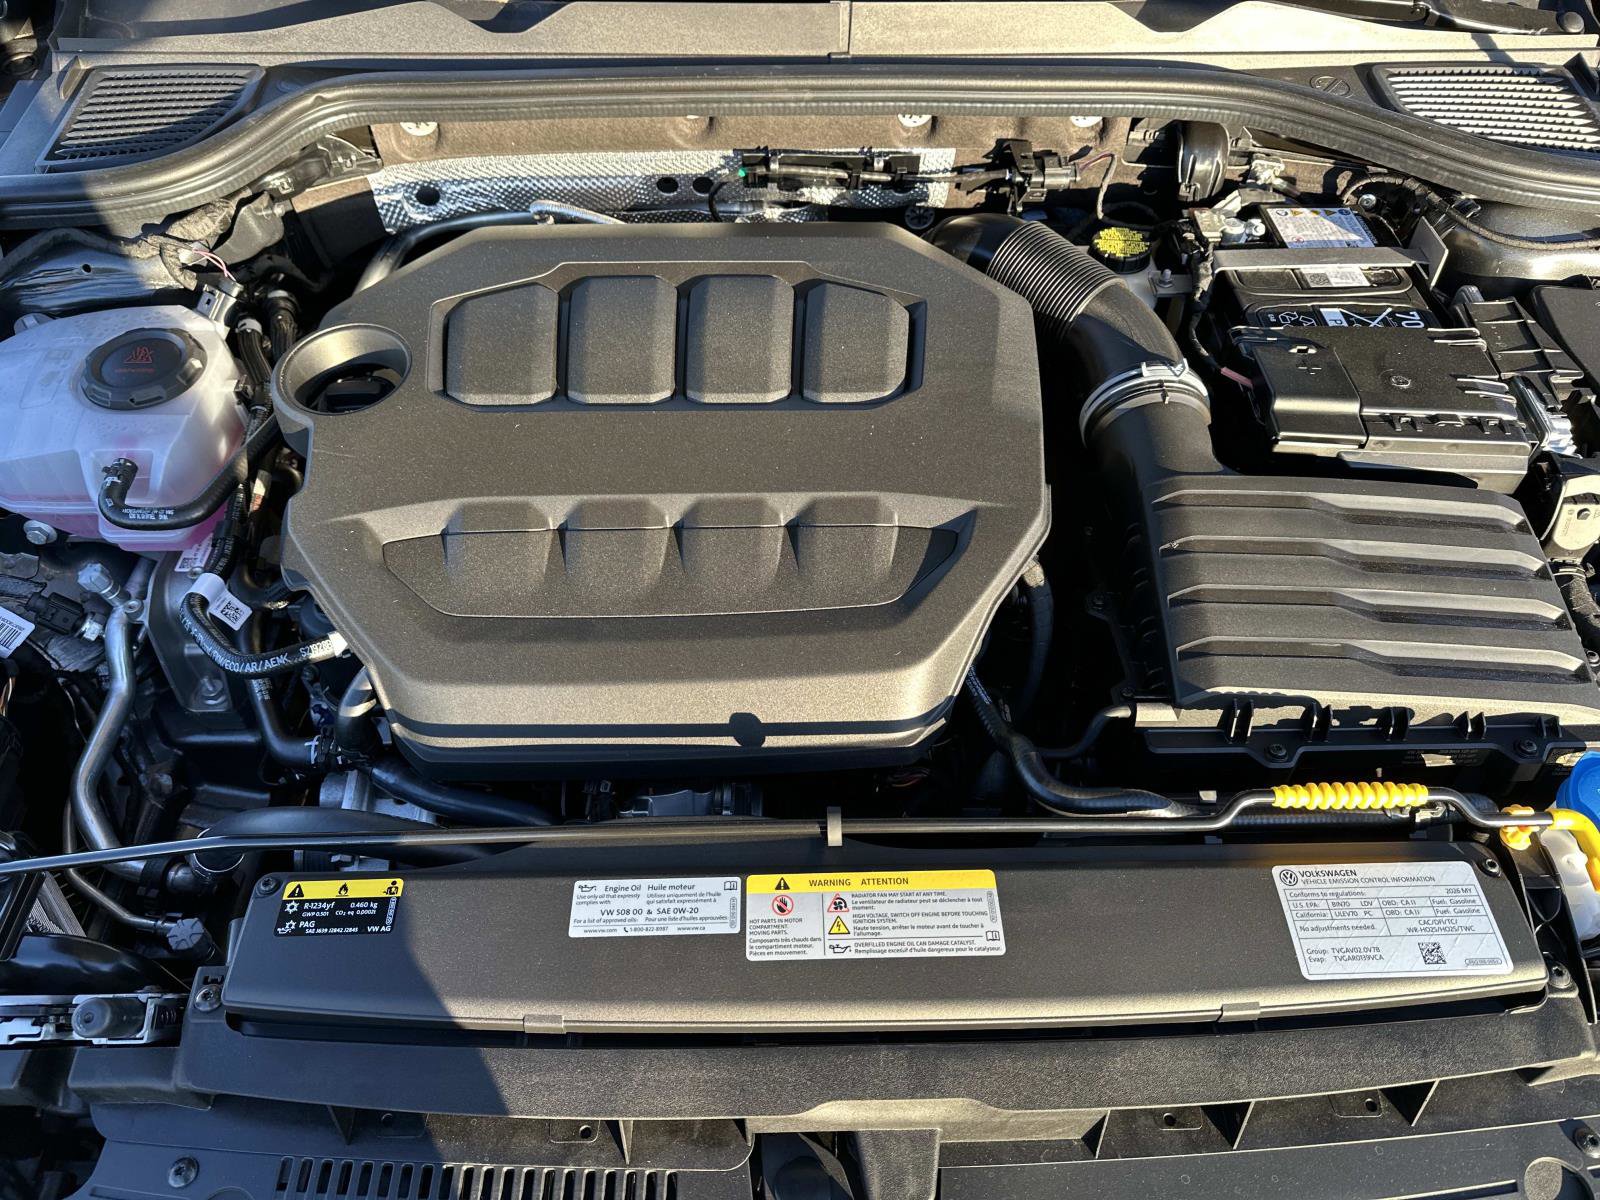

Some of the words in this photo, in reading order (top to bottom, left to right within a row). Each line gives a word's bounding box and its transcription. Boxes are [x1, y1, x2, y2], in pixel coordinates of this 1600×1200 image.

[809, 879, 851, 887] WARNING
[605, 885, 629, 894] Engine
[304, 902, 335, 910] R-1234yf
[1311, 925, 1350, 933] adjustments
